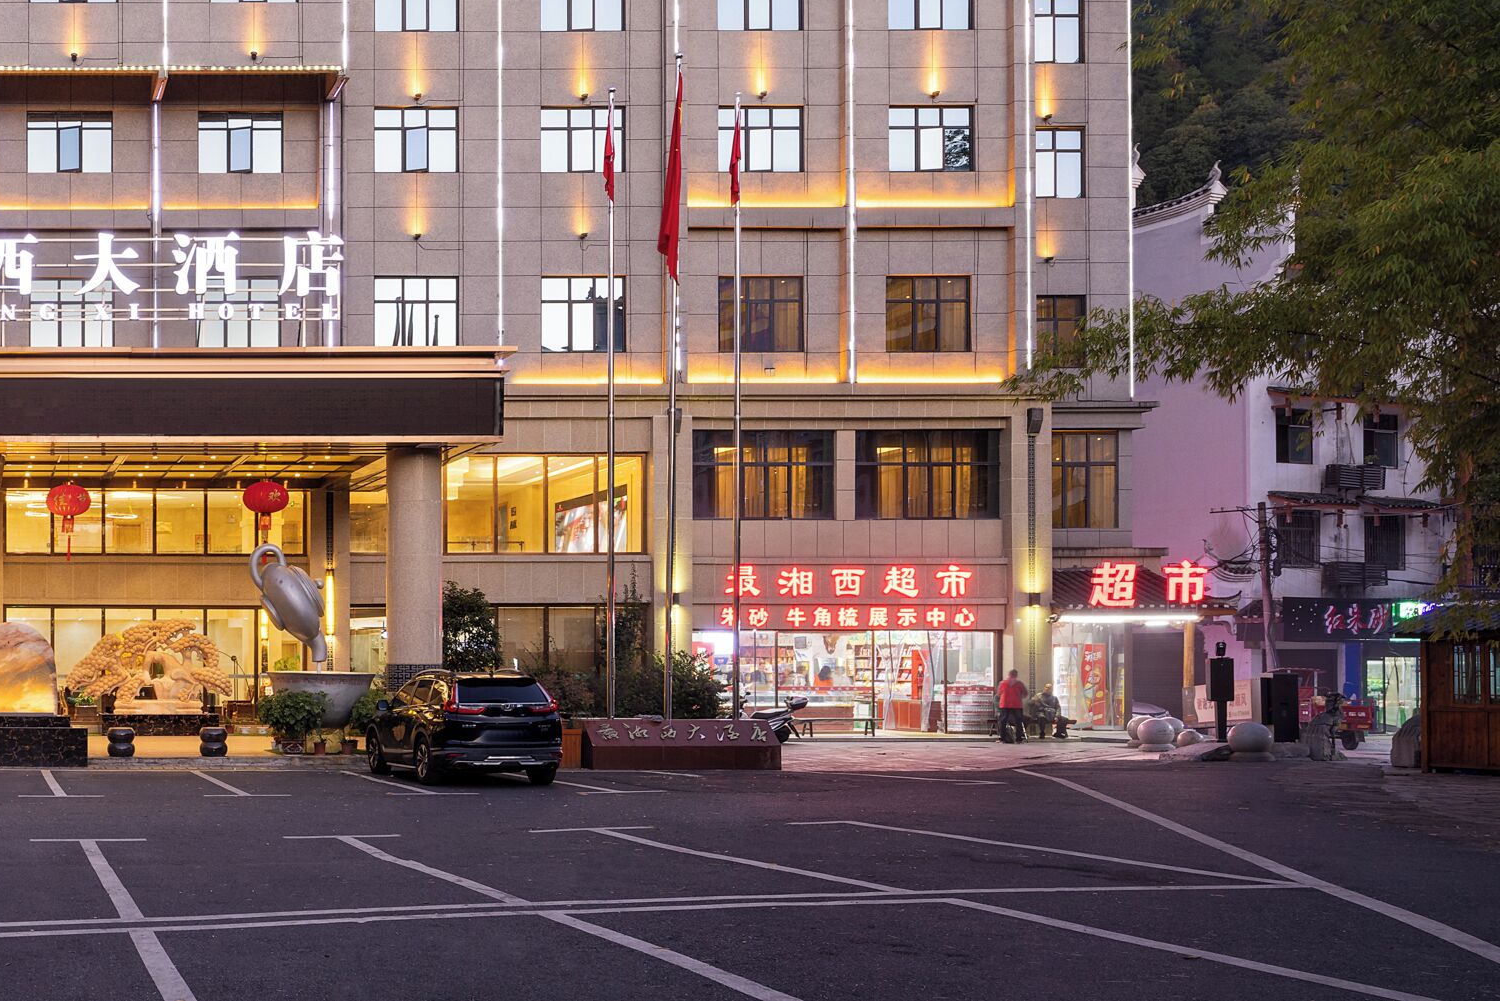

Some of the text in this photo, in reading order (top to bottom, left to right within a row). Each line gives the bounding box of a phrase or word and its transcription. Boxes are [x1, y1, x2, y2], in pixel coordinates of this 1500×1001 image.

[95, 303, 140, 321] XI
[188, 302, 339, 320] HOTEL
[724, 564, 973, 598] 最湘西超市
[1088, 559, 1208, 607] 超市
